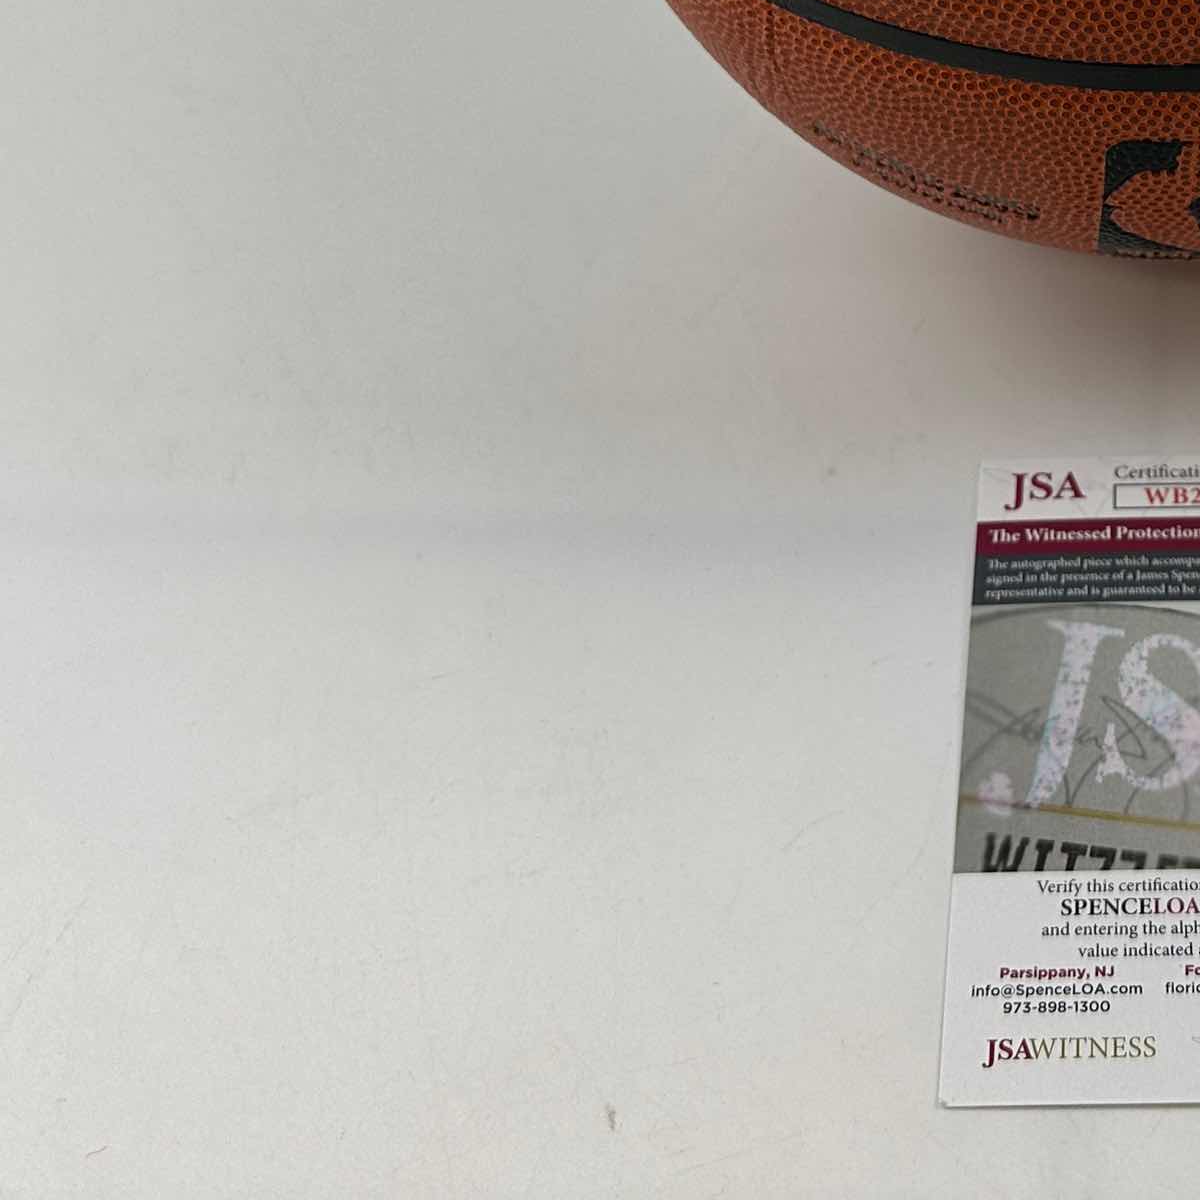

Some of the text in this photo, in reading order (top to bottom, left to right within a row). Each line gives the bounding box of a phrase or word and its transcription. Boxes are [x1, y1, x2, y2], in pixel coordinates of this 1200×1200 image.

[1003, 471, 1086, 511] JSA
[989, 528, 1021, 543] The
[1025, 526, 1111, 542] Witnessed
[988, 559, 1009, 569] The
[1010, 556, 1081, 570] autographed
[1115, 555, 1149, 567] which
[985, 572, 1023, 586] signed
[1026, 573, 1034, 583] in
[1039, 572, 1058, 582] the
[1061, 573, 1109, 584] presence
[1112, 569, 1125, 580] of
[985, 587, 1064, 600] representative
[1066, 585, 1089, 596] and
[1168, 584, 1181, 593] to
[1182, 583, 1196, 593] be
[1038, 879, 1082, 896] Verify
[1087, 879, 1114, 892] this
[1041, 923, 1070, 937] and
[1074, 922, 1138, 939] entering
[1142, 921, 1167, 936] the
[1078, 943, 1119, 958] value
[1123, 942, 1194, 957] indicated
[1000, 965, 1115, 980] Parsippany, NJ
[971, 983, 1143, 998] info@SpenceLOA.com
[1003, 1000, 1111, 1014] 973-898-1300
